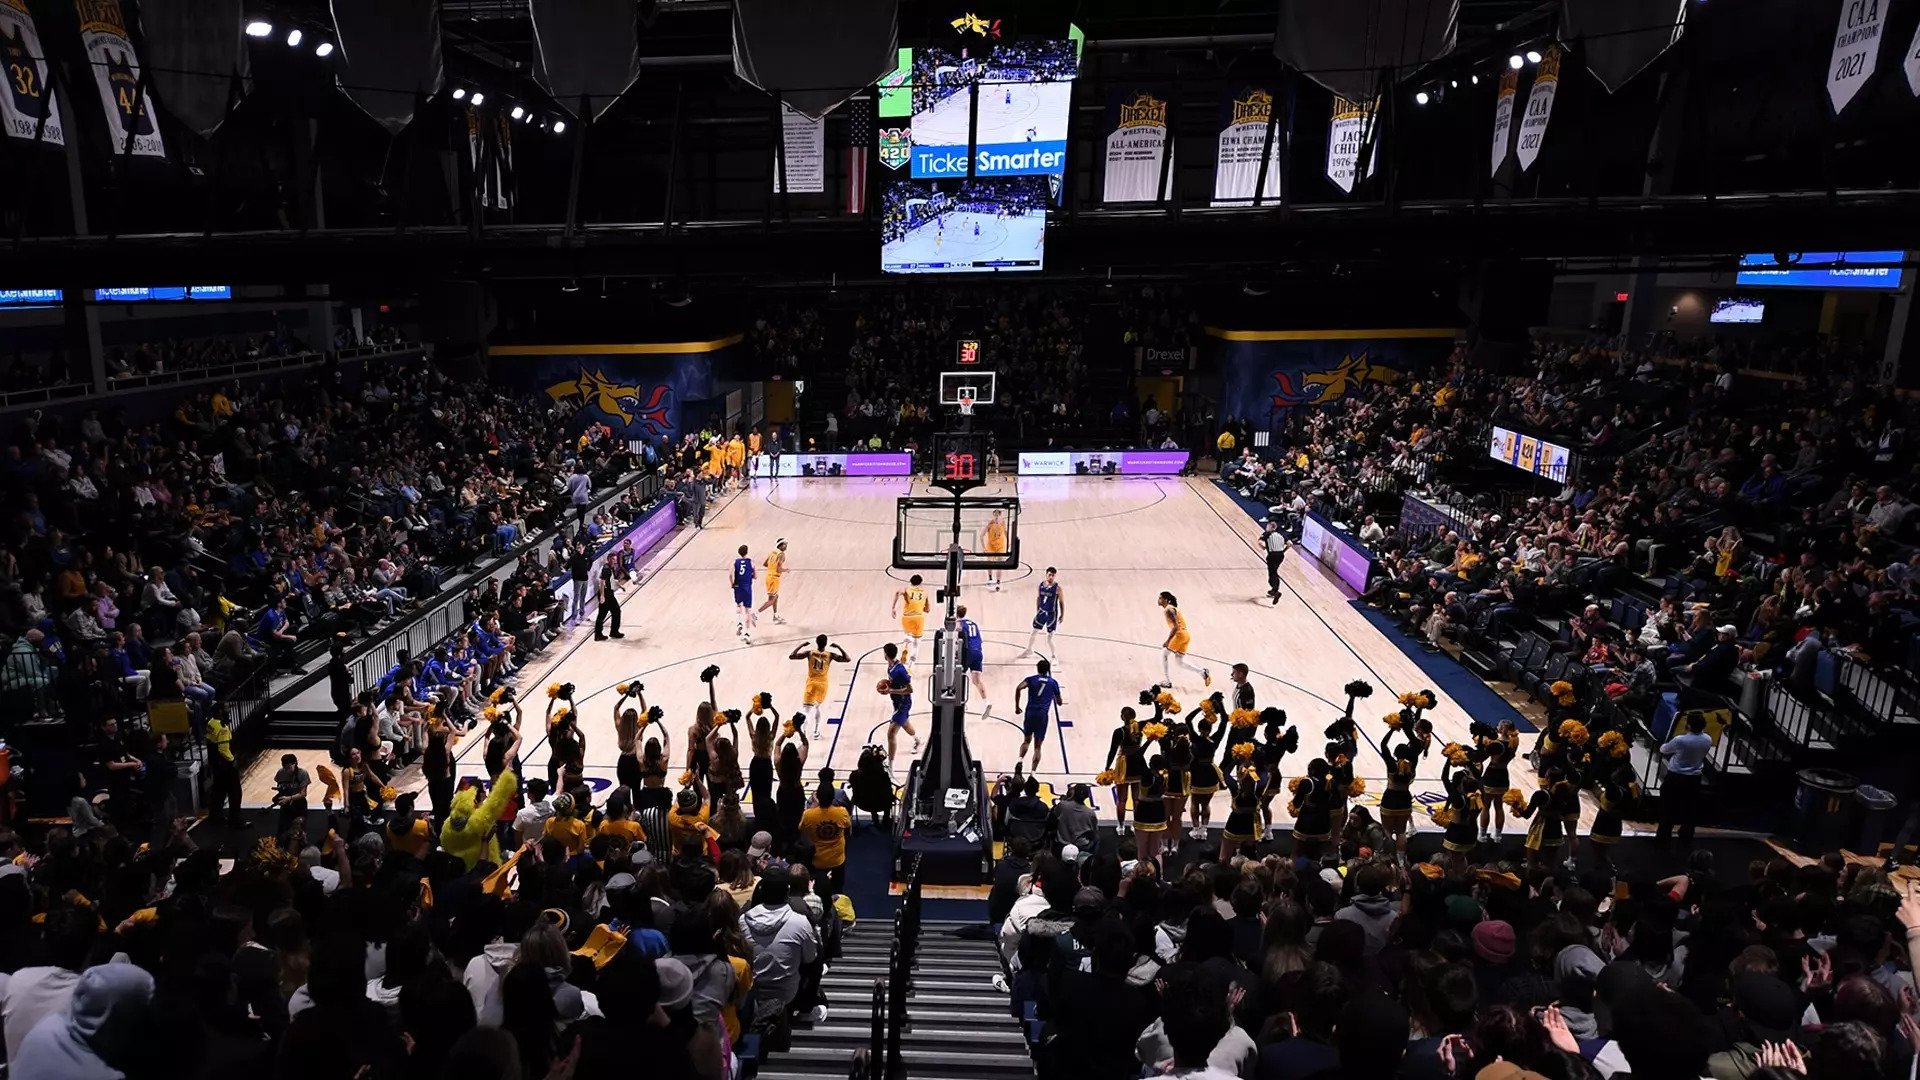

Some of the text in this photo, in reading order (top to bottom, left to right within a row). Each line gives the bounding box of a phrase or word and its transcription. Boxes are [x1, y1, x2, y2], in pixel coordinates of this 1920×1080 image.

[1847, 0, 1879, 29] CAA
[1835, 51, 1867, 82] 2021
[10, 64, 39, 97] 32
[1122, 127, 1162, 137] WRESTLING
[1221, 136, 1241, 146] EIWA
[879, 147, 909, 159] 420
[960, 350, 976, 362] 30
[1146, 348, 1185, 360] Drexel
[945, 453, 974, 479] 30
[739, 564, 746, 576] 5
[909, 591, 923, 601] 13
[968, 624, 977, 637] 11
